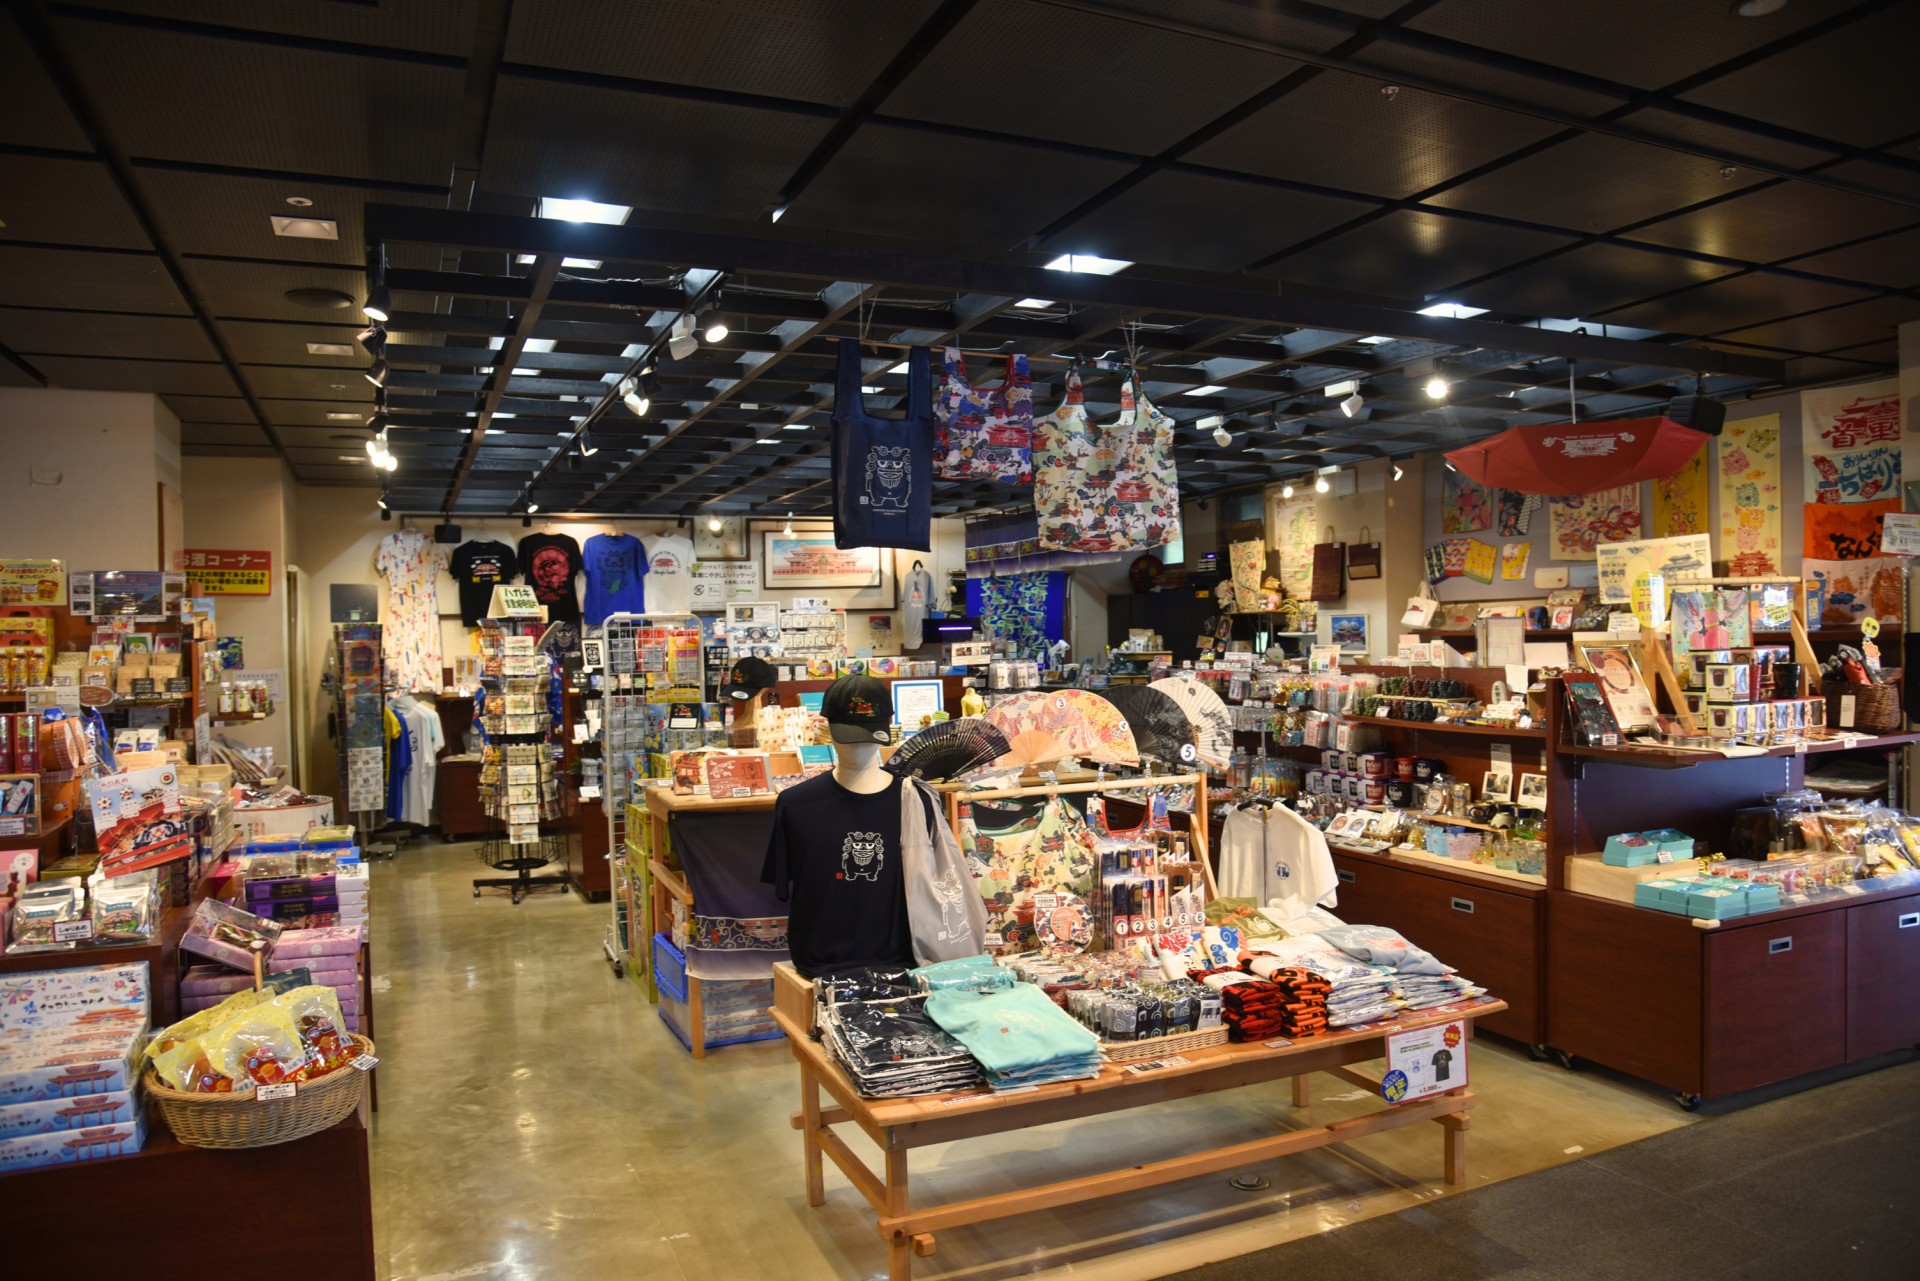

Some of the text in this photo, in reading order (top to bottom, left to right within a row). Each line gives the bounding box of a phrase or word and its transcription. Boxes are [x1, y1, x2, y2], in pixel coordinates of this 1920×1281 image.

[504, 588, 531, 598] ハガキ
[59, 924, 88, 933] しゅりあめ
